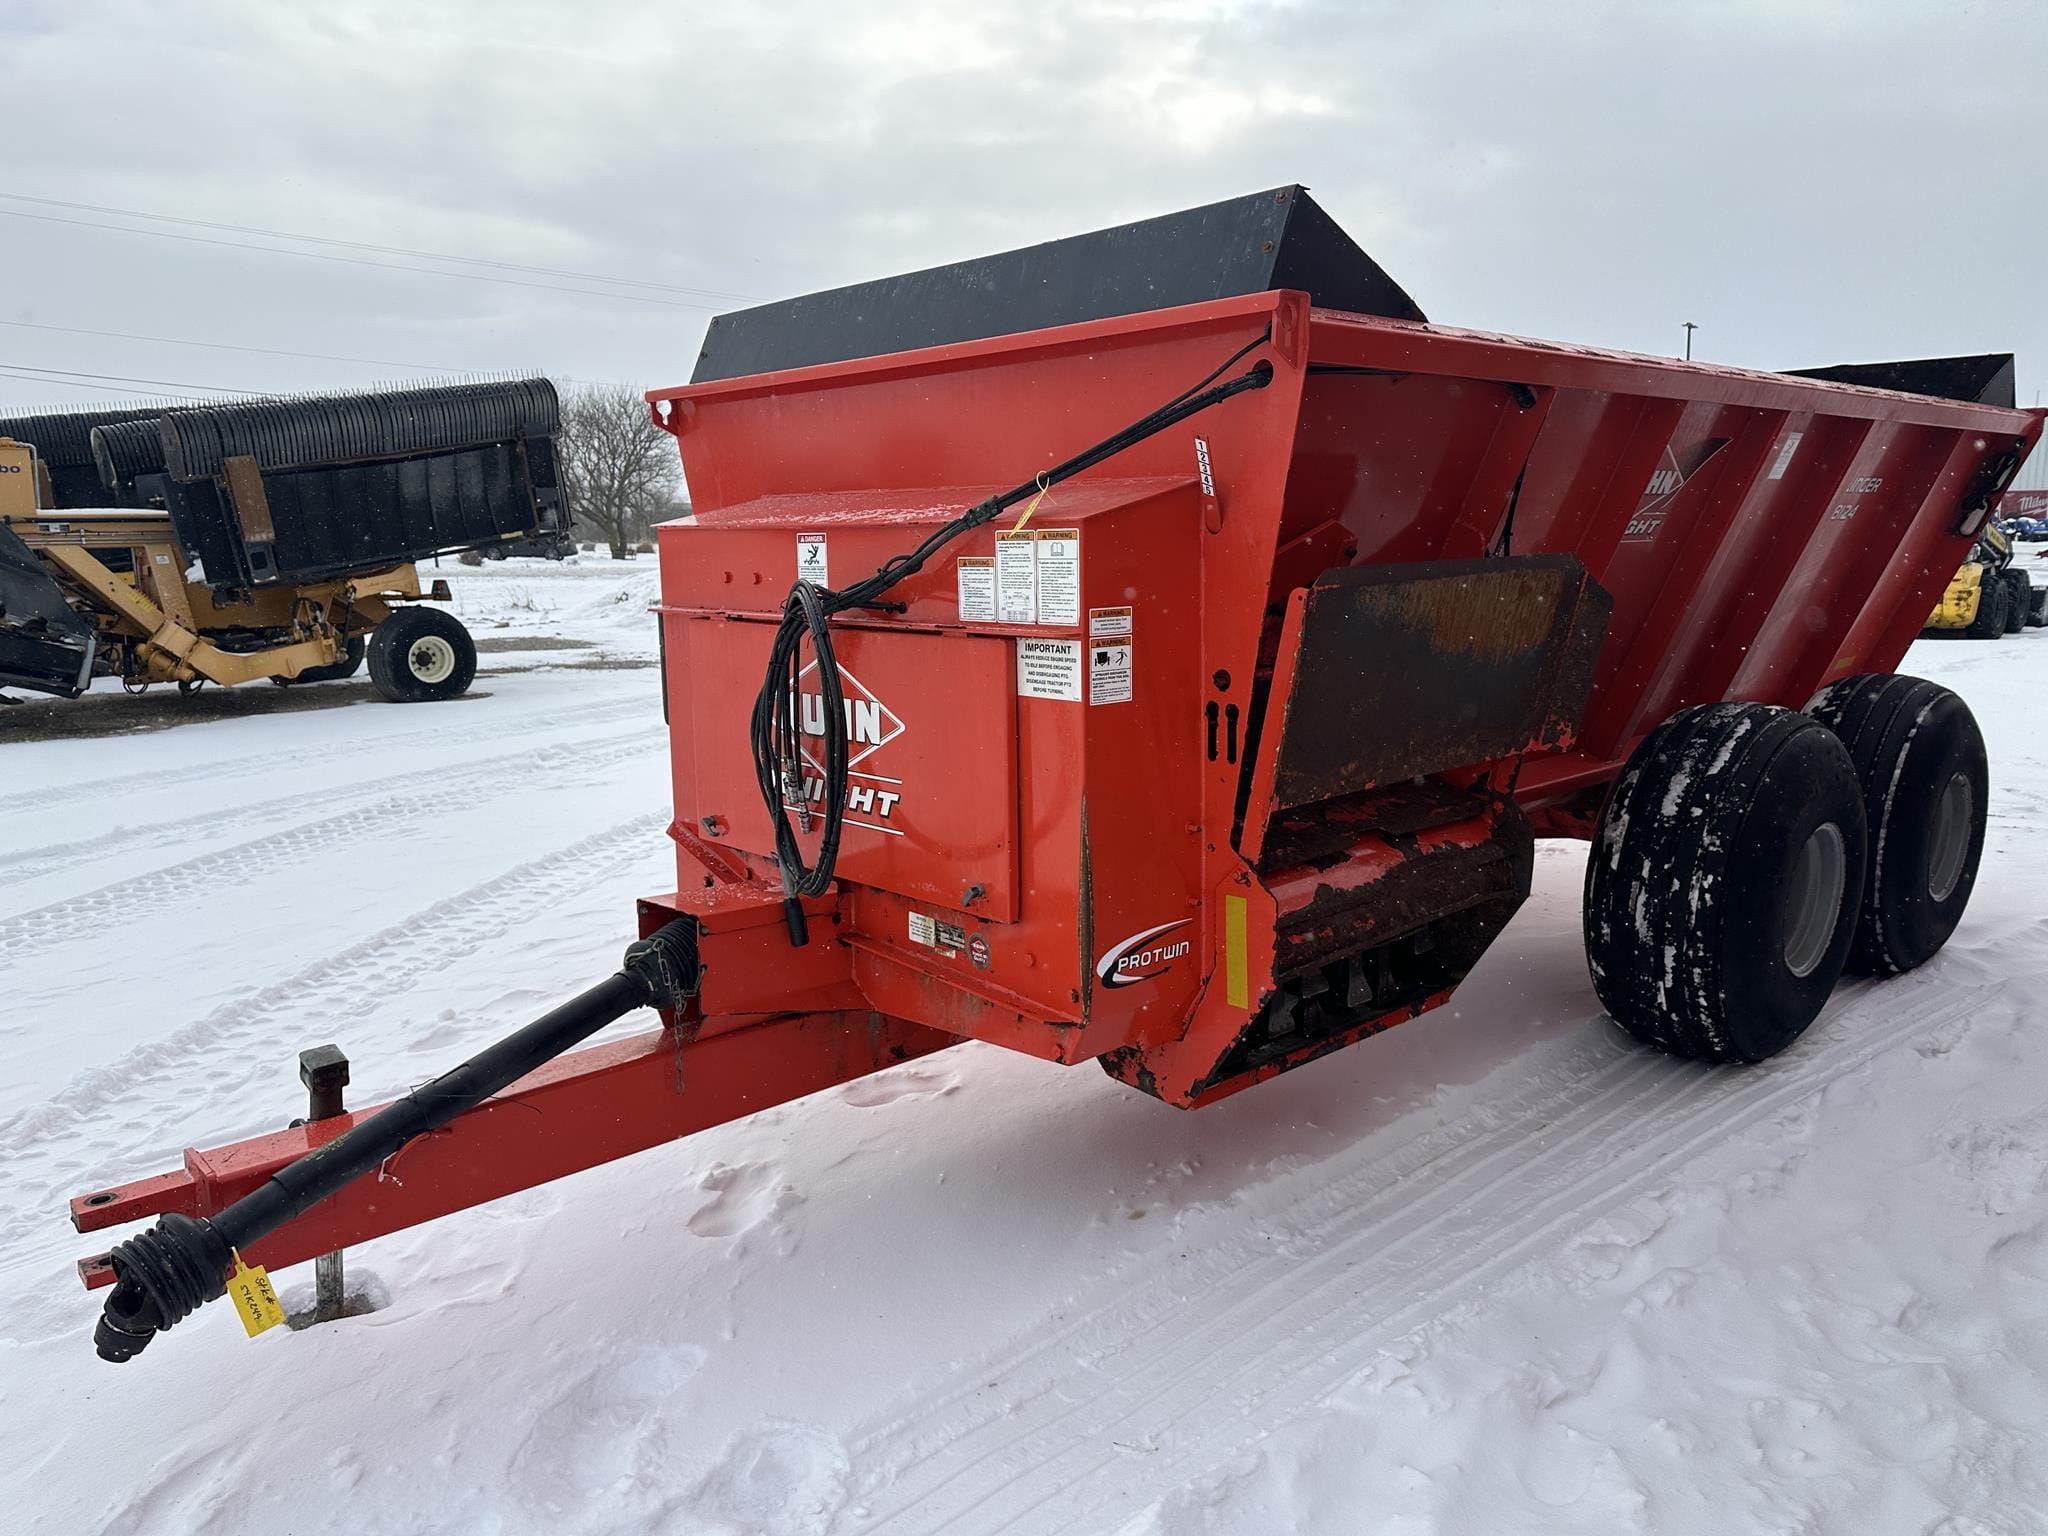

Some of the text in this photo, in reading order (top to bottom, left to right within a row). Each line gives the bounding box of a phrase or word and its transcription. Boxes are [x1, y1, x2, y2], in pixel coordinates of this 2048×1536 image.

[1199, 441, 1204, 450] 1
[1200, 453, 1206, 461] 2
[1202, 464, 1208, 473] 3
[1204, 476, 1210, 484] 4
[1206, 486, 1211, 495] 5
[805, 535, 824, 543] DANGER
[1048, 531, 1073, 539] WARNING
[1102, 609, 1125, 617] WARNING
[1102, 638, 1126, 647] WARNING
[1025, 643, 1072, 655] IMPORTANT
[1117, 941, 1190, 972] PROTWIN
